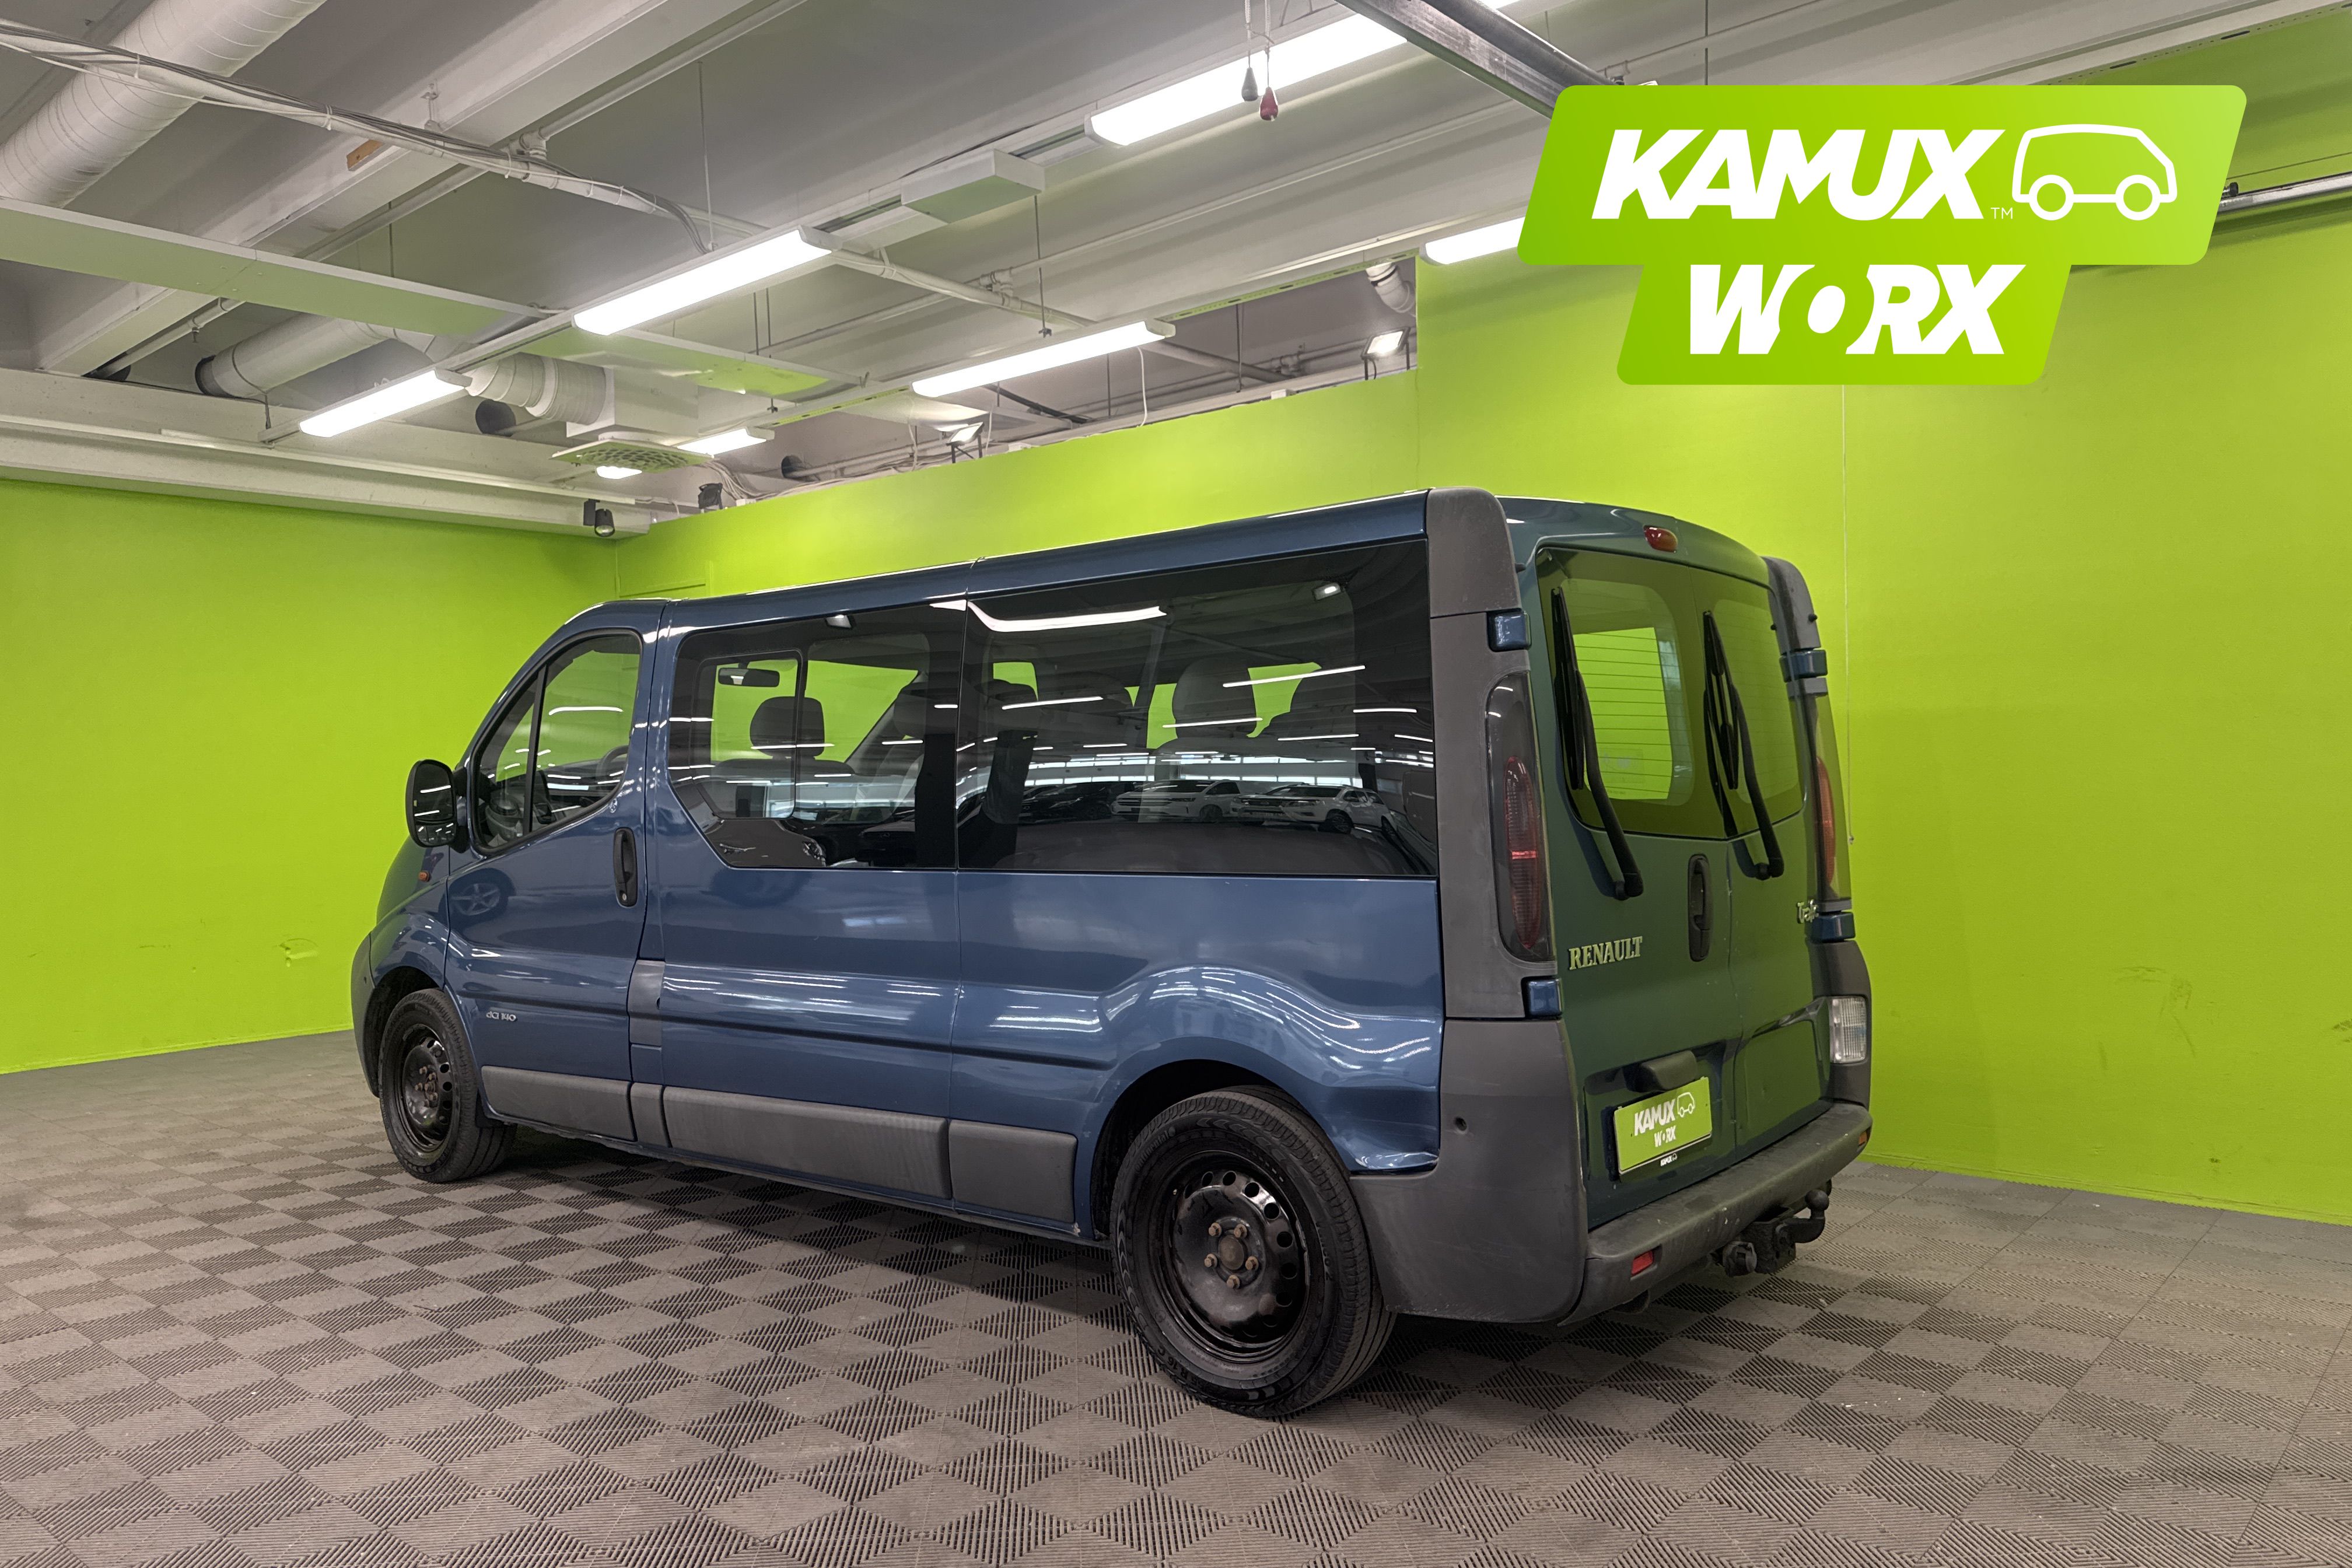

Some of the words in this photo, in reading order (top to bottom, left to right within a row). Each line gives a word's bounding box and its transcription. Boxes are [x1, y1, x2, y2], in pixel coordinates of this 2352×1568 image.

[1568, 935, 1643, 971] RENAULT
[501, 1013, 516, 1021] 140
[1634, 1099, 1675, 1136] KAMUX
[1654, 1125, 1676, 1147] WORX
